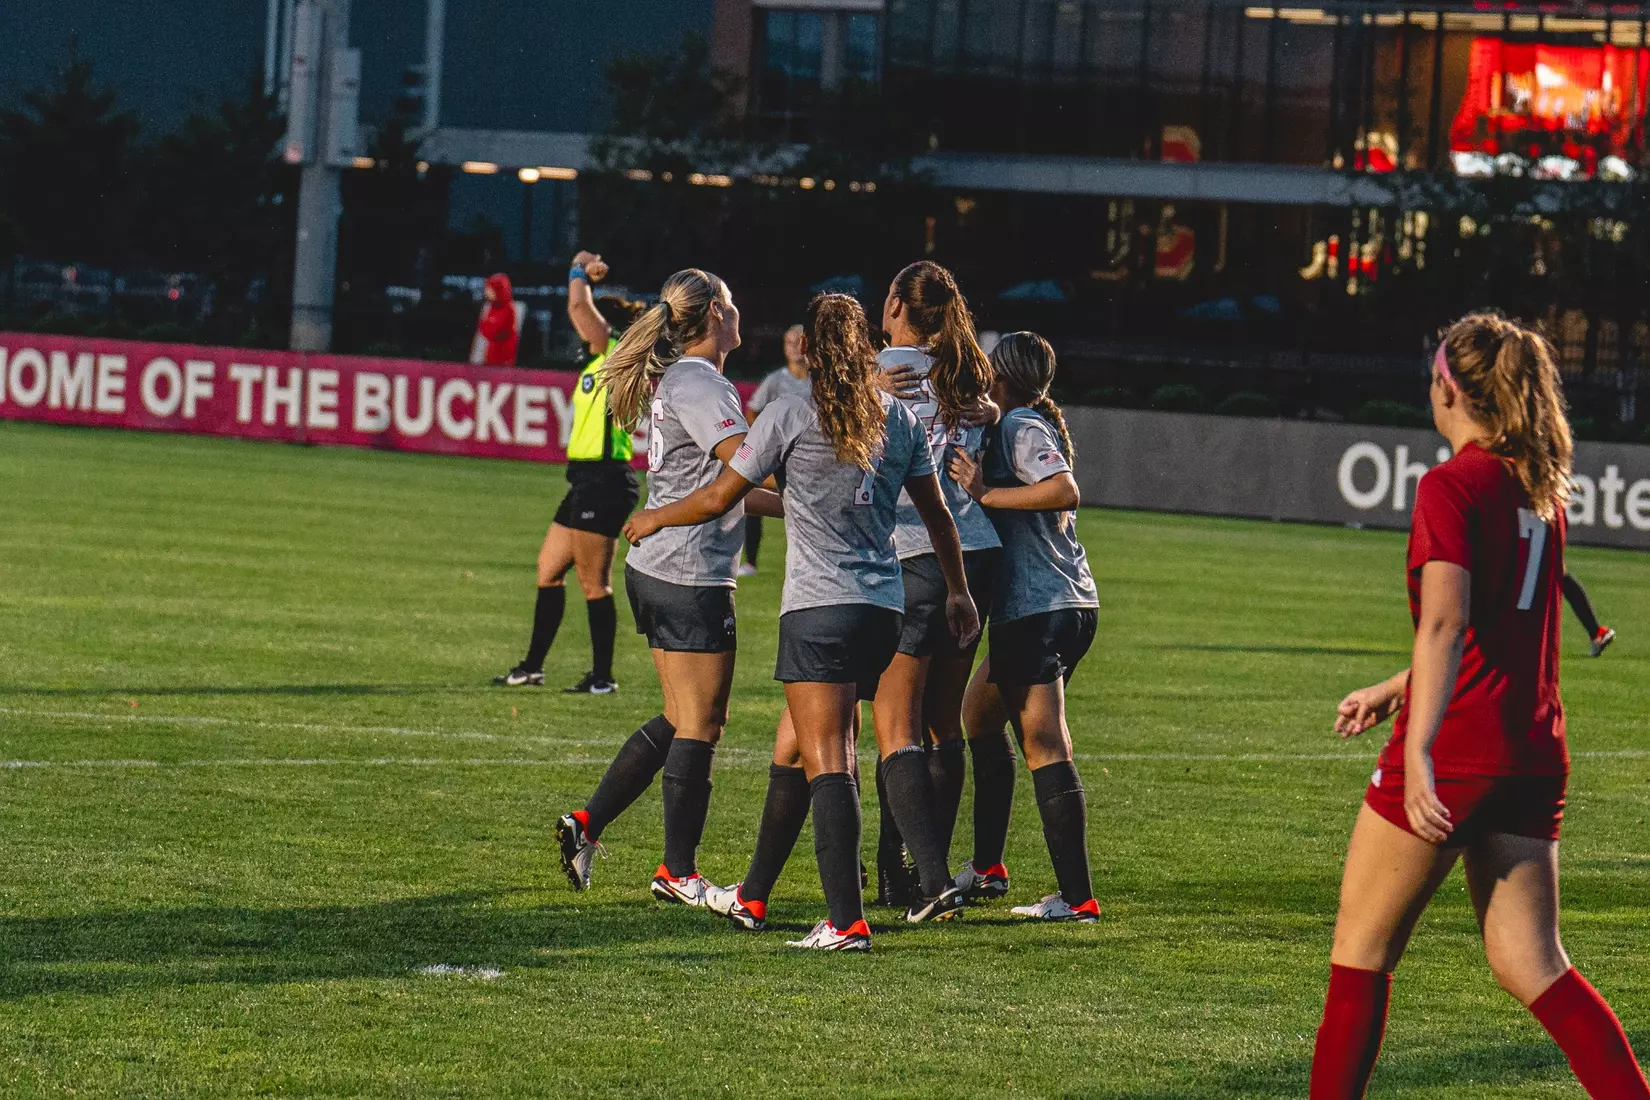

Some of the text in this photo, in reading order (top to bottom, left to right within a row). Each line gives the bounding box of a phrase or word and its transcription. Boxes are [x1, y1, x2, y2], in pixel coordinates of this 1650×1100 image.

[0, 346, 651, 453] OME OF THE BUCKEY
[1338, 441, 1650, 531] Oh ate
[1516, 507, 1547, 611] 7
